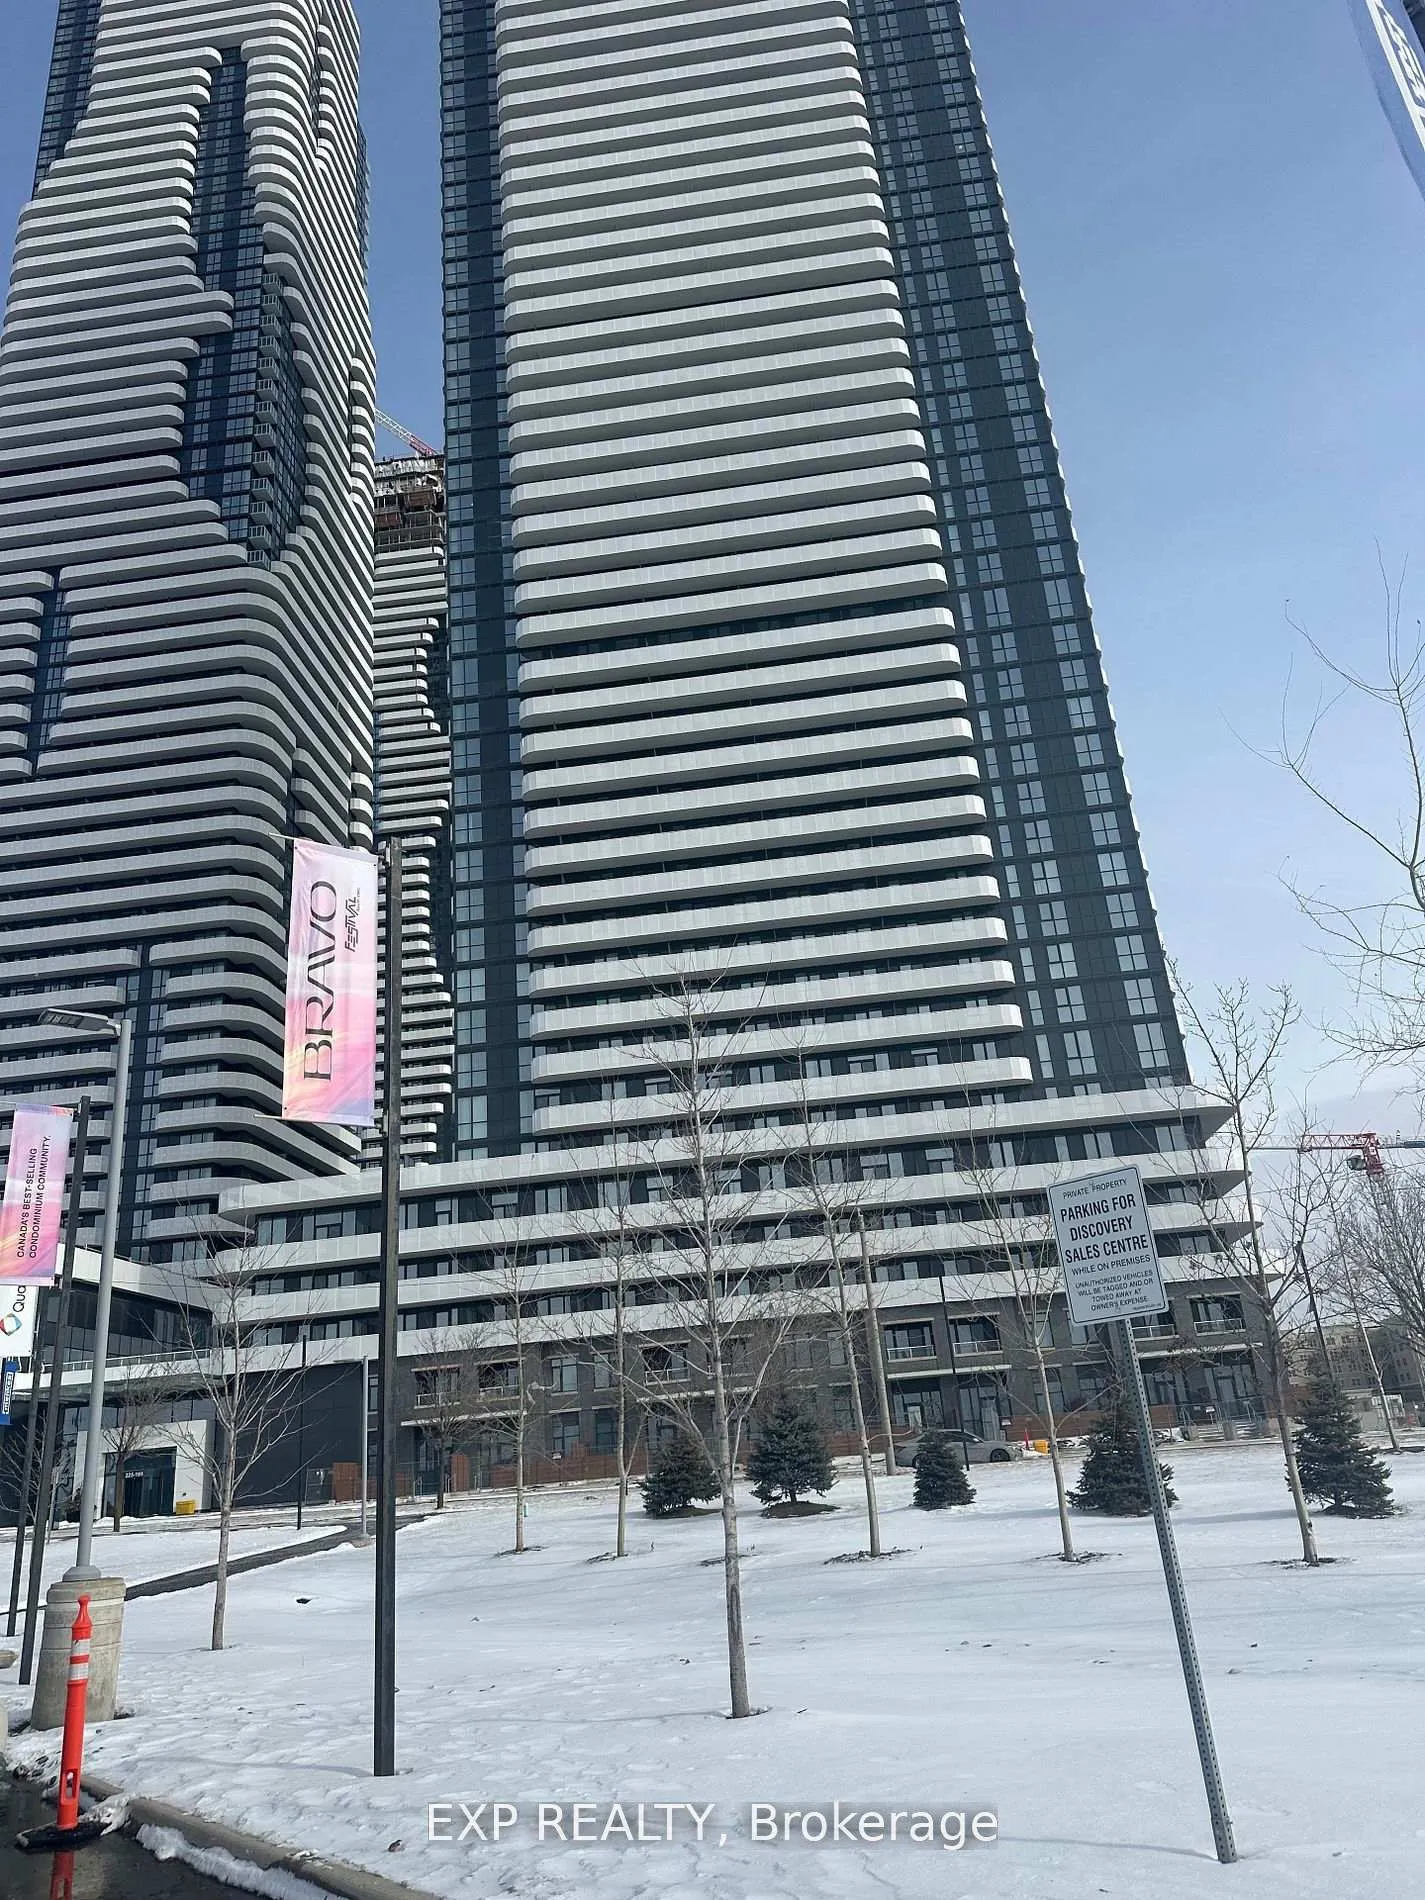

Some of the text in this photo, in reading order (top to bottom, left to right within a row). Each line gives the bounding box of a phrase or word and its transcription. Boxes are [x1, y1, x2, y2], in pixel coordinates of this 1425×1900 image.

[344, 896, 359, 952] FESTIVAL
[304, 880, 337, 1080] BRAVO
[1062, 1177, 1128, 1200] PRIVATE PROPERTY
[17, 1147, 38, 1258] CANADA'S BEST-SELLING
[1060, 1193, 1136, 1222] PARKING FOR
[29, 1192, 44, 1259] CONDOMINIUM
[1070, 1215, 1133, 1241] DISCOVERY
[1065, 1234, 1149, 1264] SALES CENTRE
[1072, 1254, 1151, 1276] WHILE ON PREMISES
[1075, 1269, 1154, 1289] UNAUTHORIZED VEHICLES
[1078, 1277, 1154, 1296] WILL BE TAGGED AND OR
[1092, 1287, 1142, 1303] TOWED AWAY AT
